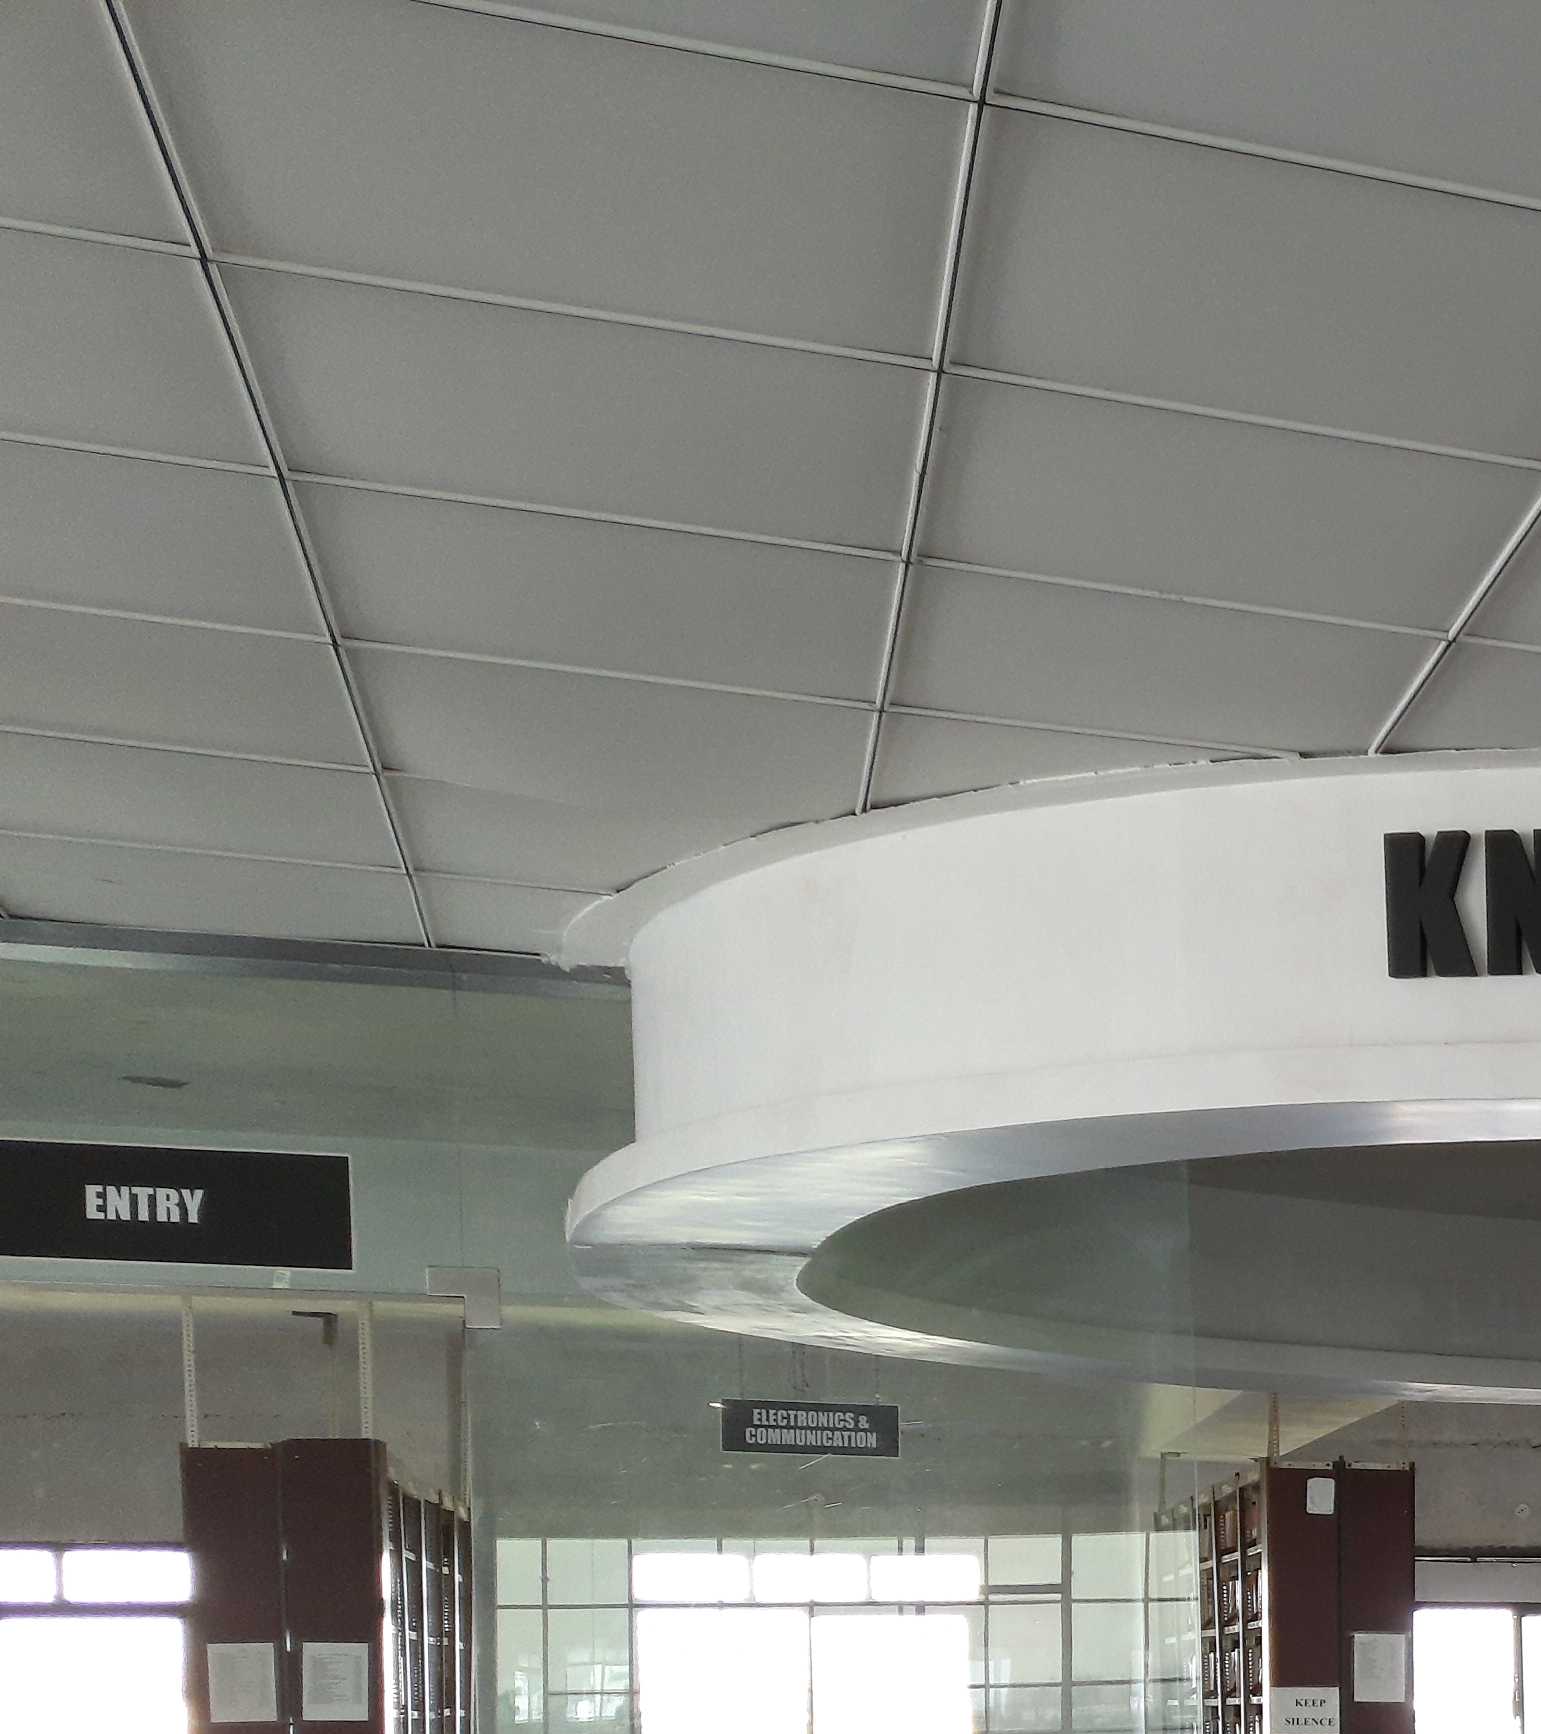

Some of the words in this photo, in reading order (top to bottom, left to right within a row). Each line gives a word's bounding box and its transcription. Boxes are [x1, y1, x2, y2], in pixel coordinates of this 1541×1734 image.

[84, 1184, 204, 1224] ENTRY
[752, 1408, 855, 1429] ELECTRONICS
[857, 1415, 870, 1429] &
[745, 1427, 878, 1448] COMMUNICATION
[1295, 1698, 1327, 1708] KEEP
[1284, 1717, 1336, 1727] SILENCE
